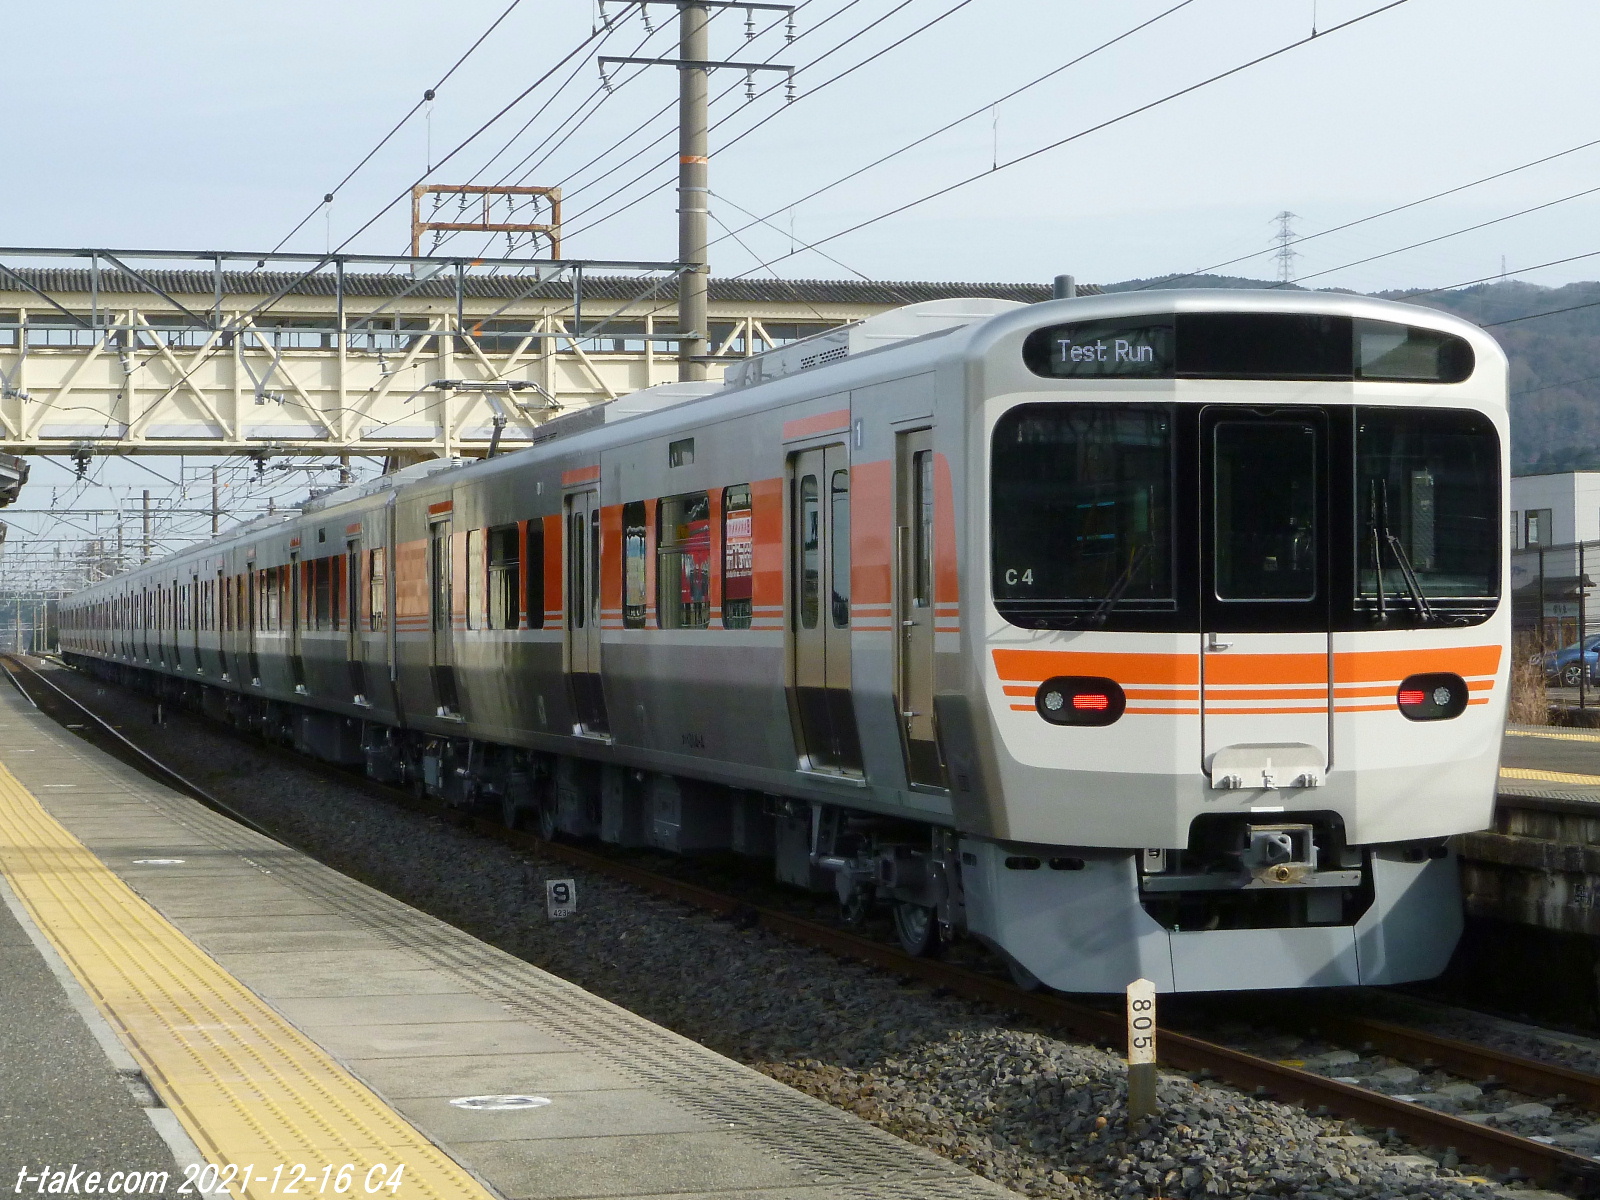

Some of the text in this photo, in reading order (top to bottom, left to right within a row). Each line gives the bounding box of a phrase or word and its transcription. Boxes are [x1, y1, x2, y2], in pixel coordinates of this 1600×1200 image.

[1057, 339, 1153, 362] Test Run
[856, 421, 861, 447] 1
[552, 882, 570, 904] 9
[1132, 999, 1153, 1049] 805
